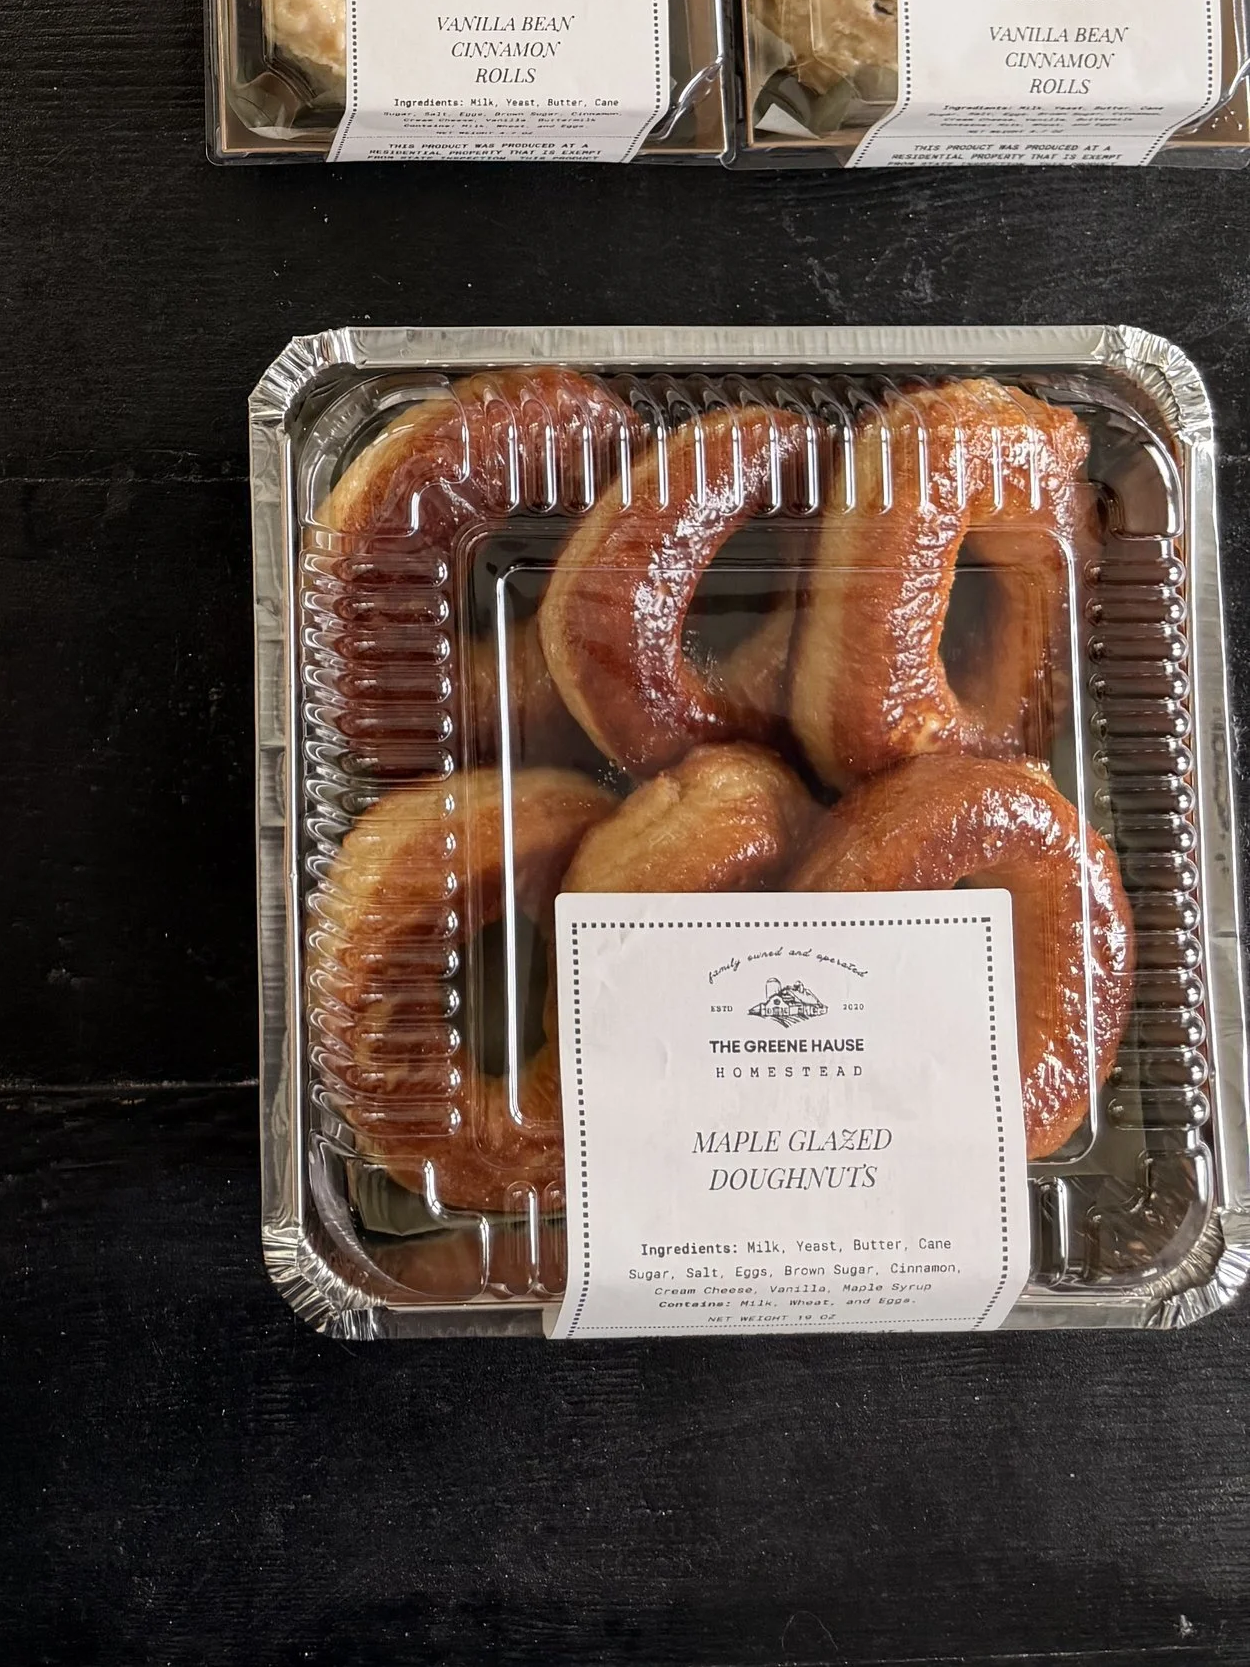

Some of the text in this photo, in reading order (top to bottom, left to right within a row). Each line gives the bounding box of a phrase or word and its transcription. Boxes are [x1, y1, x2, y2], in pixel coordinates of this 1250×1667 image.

[438, 16, 575, 35] VANILLA BEAN
[990, 26, 1129, 44] VANILLA BEAN
[451, 41, 561, 58] CINNAMON
[1005, 52, 1115, 69] CINNAMON
[474, 68, 536, 86] ROLLS
[1030, 78, 1091, 94] ROLLS
[709, 1039, 864, 1053] THE GREENE HAUSE
[692, 1129, 892, 1153] MAPLE GLAZED
[709, 1163, 877, 1190] DOUGHNUTS
[641, 1238, 951, 1258] Ingredients: Milk, Yeast, Butter, Cane
